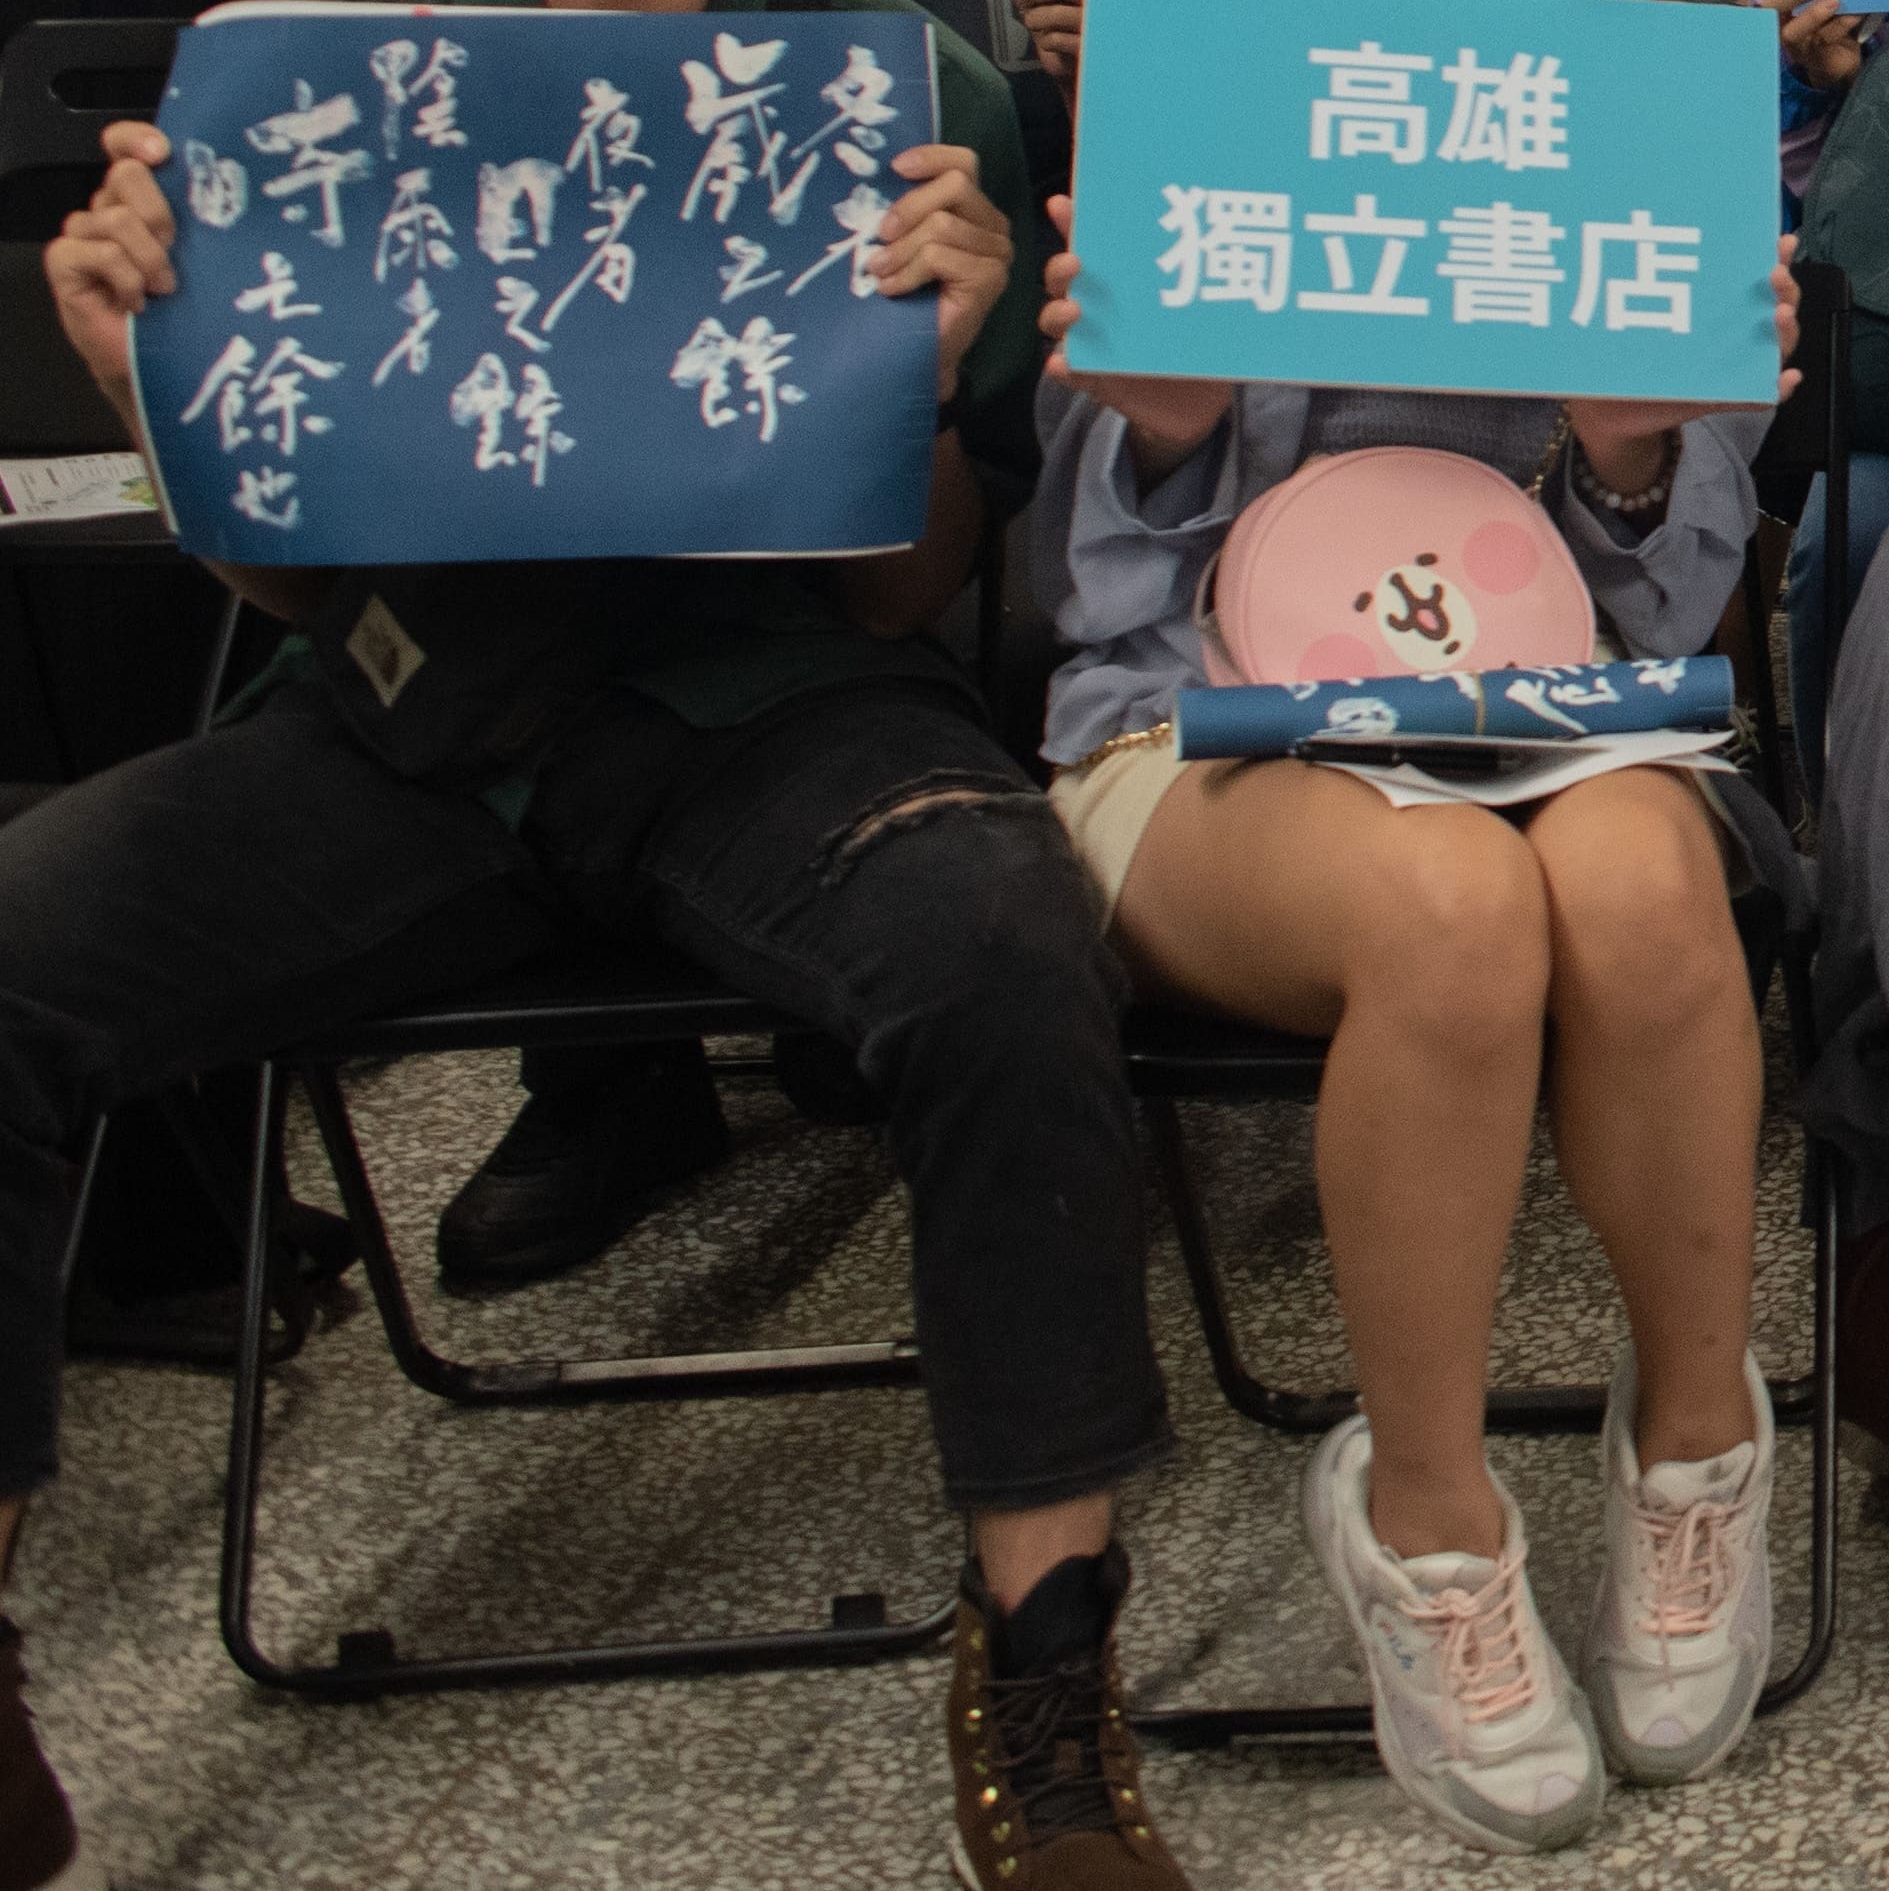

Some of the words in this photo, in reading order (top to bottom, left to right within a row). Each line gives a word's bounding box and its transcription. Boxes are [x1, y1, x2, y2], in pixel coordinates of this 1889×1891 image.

[1309, 42, 1570, 171] 高雄
[1156, 183, 1702, 334] 獨立書店
